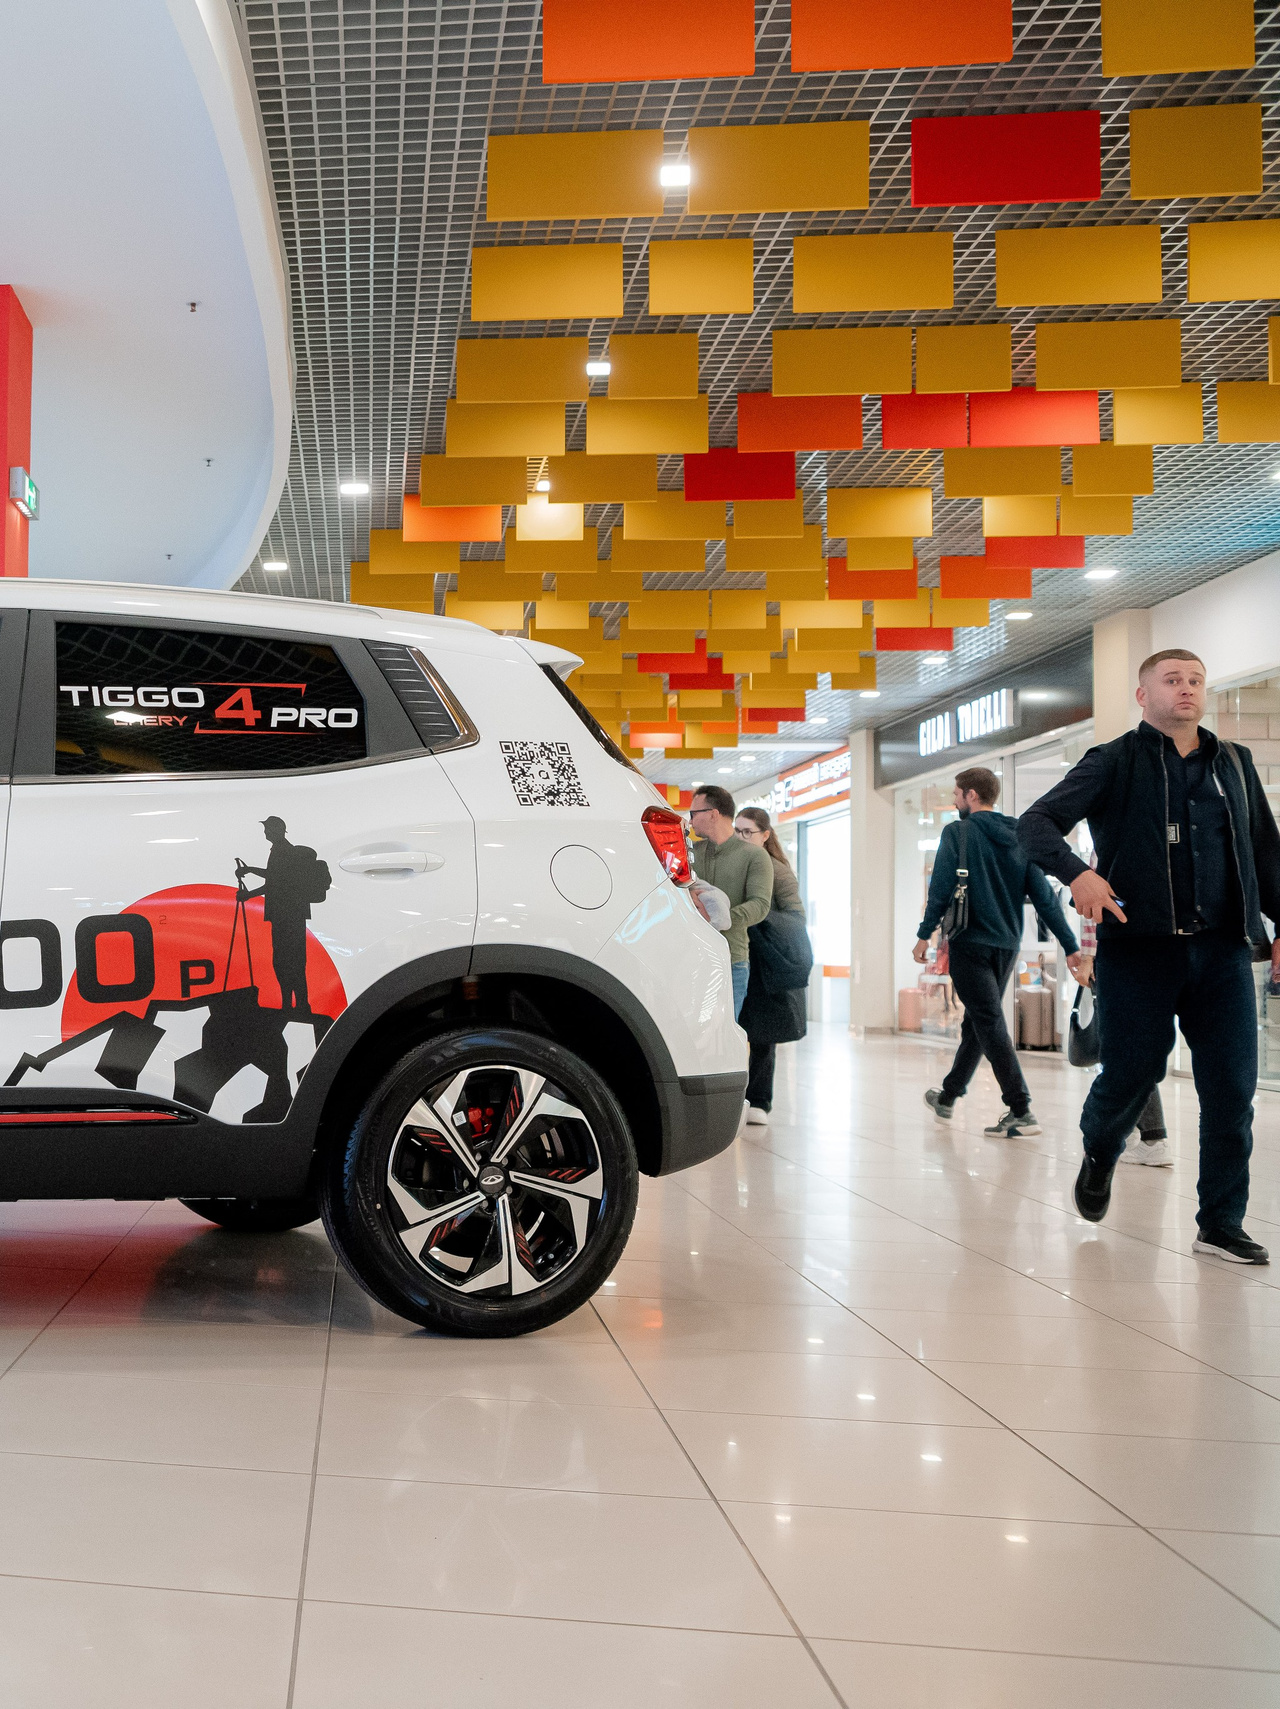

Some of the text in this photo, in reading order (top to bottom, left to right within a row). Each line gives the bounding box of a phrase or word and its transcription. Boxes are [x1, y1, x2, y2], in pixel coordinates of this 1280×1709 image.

[59, 685, 358, 728] TIGGO 4 PRO
